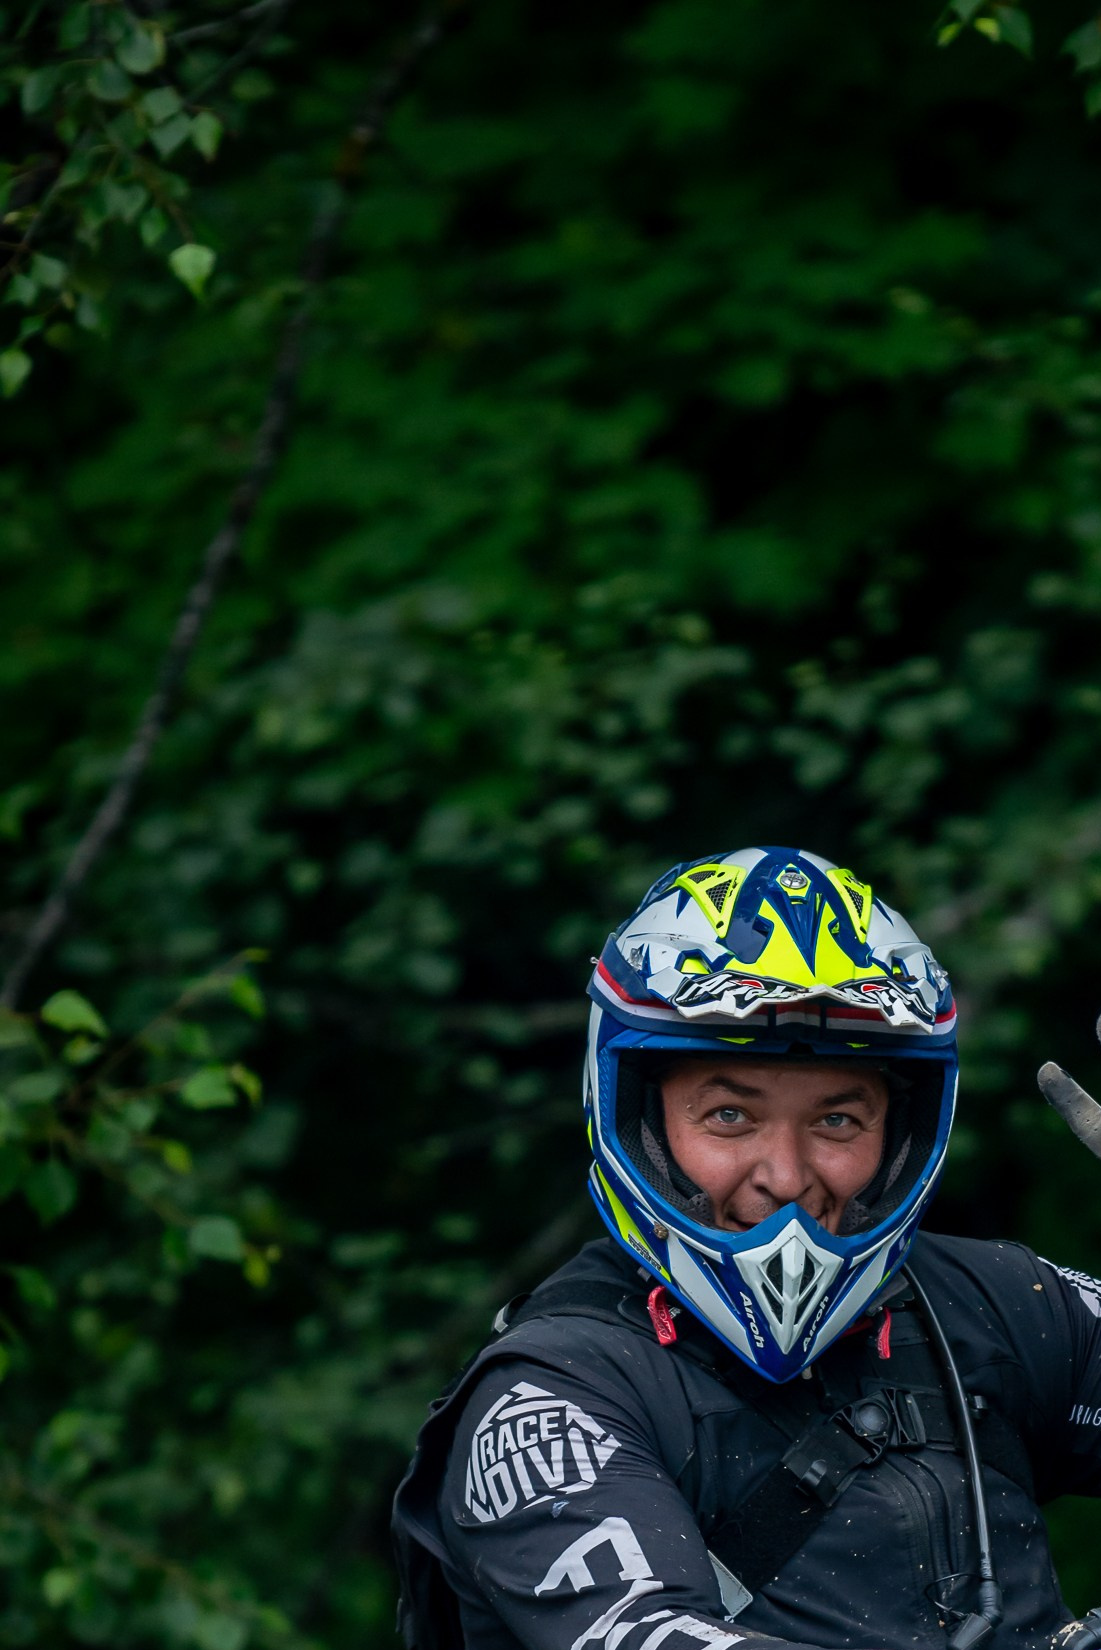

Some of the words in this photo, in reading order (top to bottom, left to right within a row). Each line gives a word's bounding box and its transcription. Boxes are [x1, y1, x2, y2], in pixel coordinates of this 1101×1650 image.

[740, 1291, 765, 1349] Airoh
[803, 1295, 829, 1353] Airoh
[480, 1411, 562, 1471] RACE
